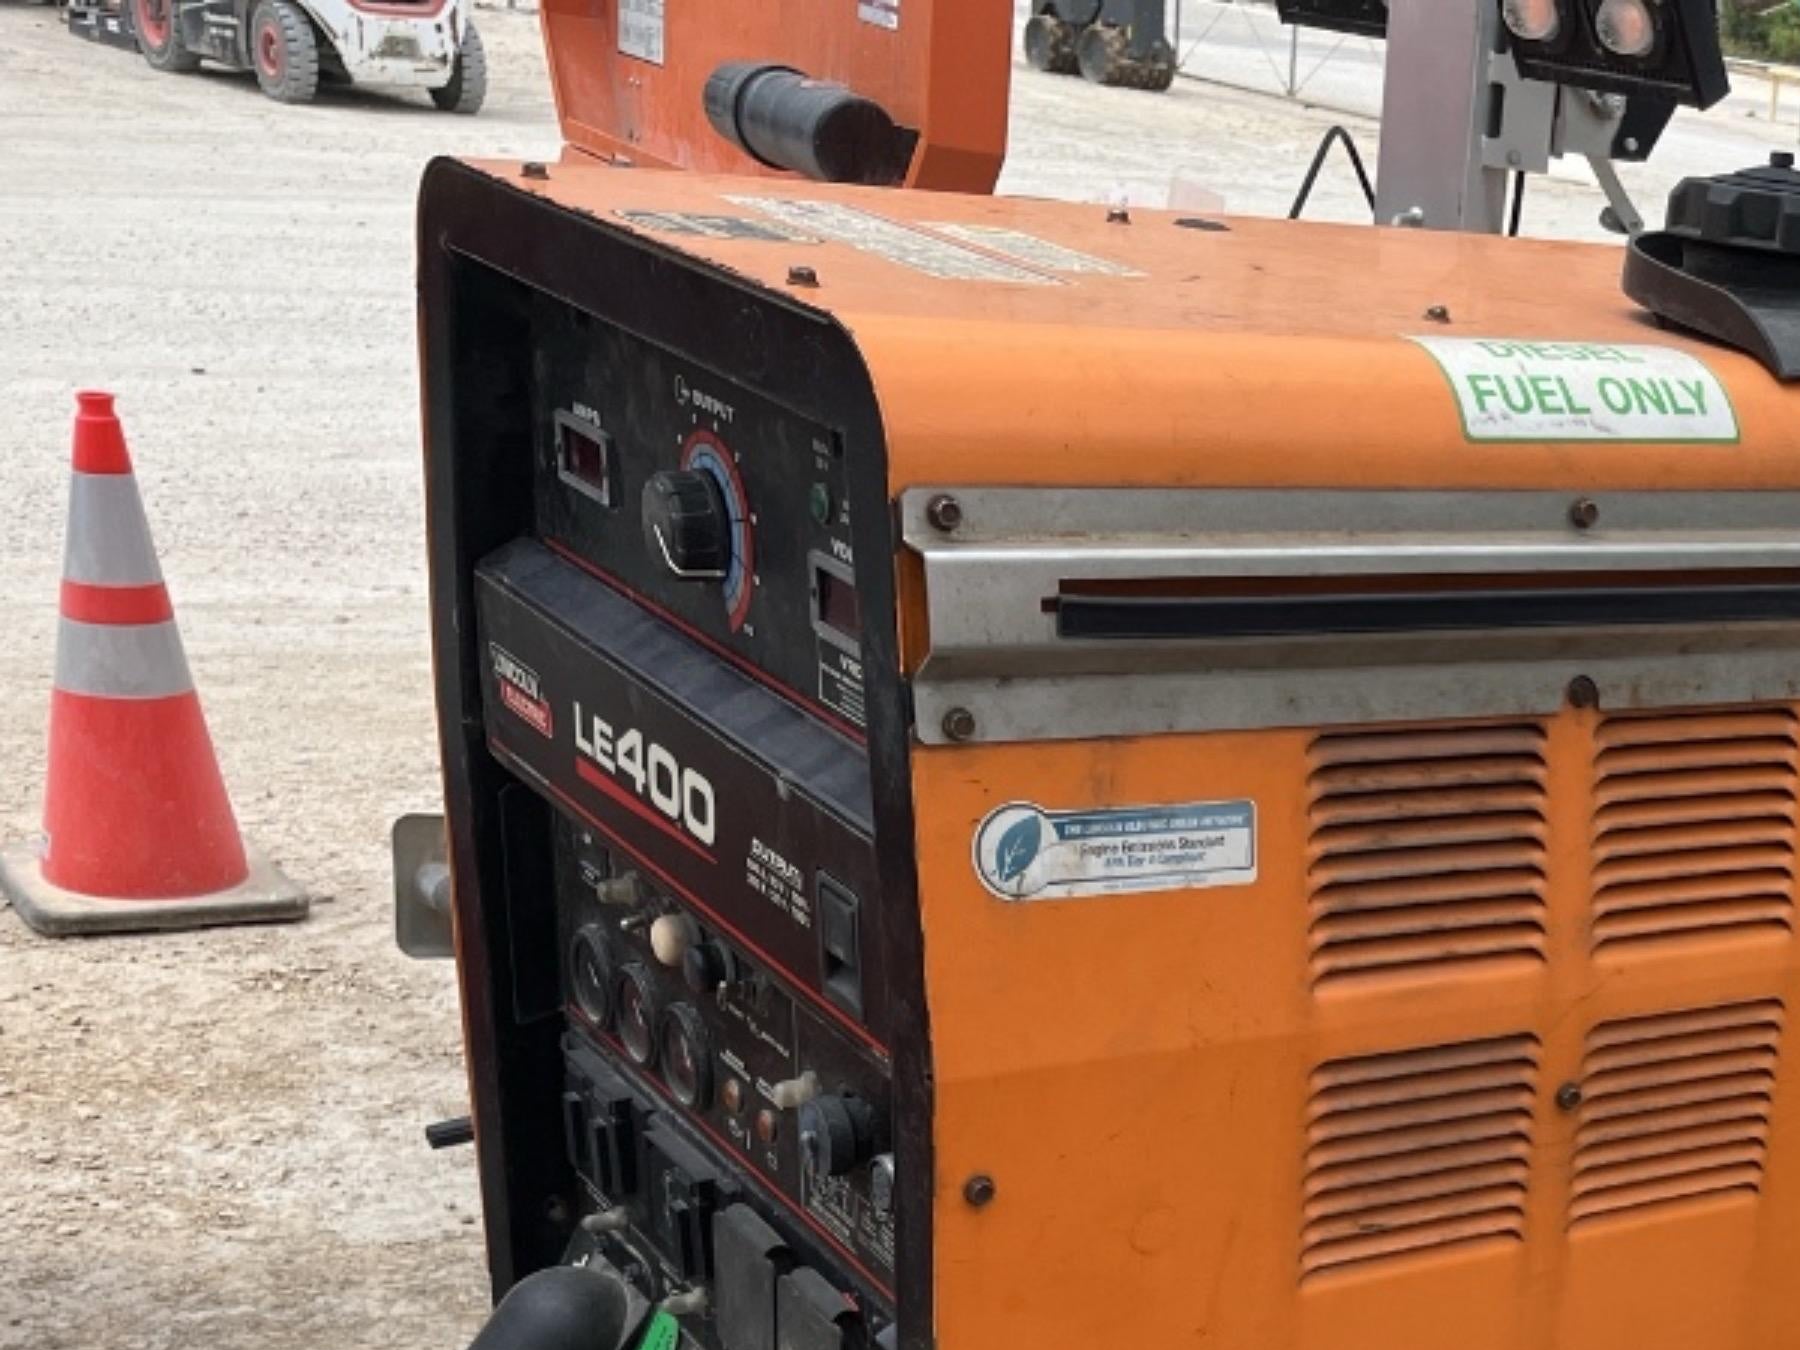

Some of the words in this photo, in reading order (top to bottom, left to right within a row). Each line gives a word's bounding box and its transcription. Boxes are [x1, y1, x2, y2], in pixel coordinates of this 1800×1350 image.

[1475, 341, 1646, 364] DIESEL
[1467, 374, 1591, 415] FUEL
[1598, 376, 1708, 416] ONLY
[573, 700, 716, 846] LE400
